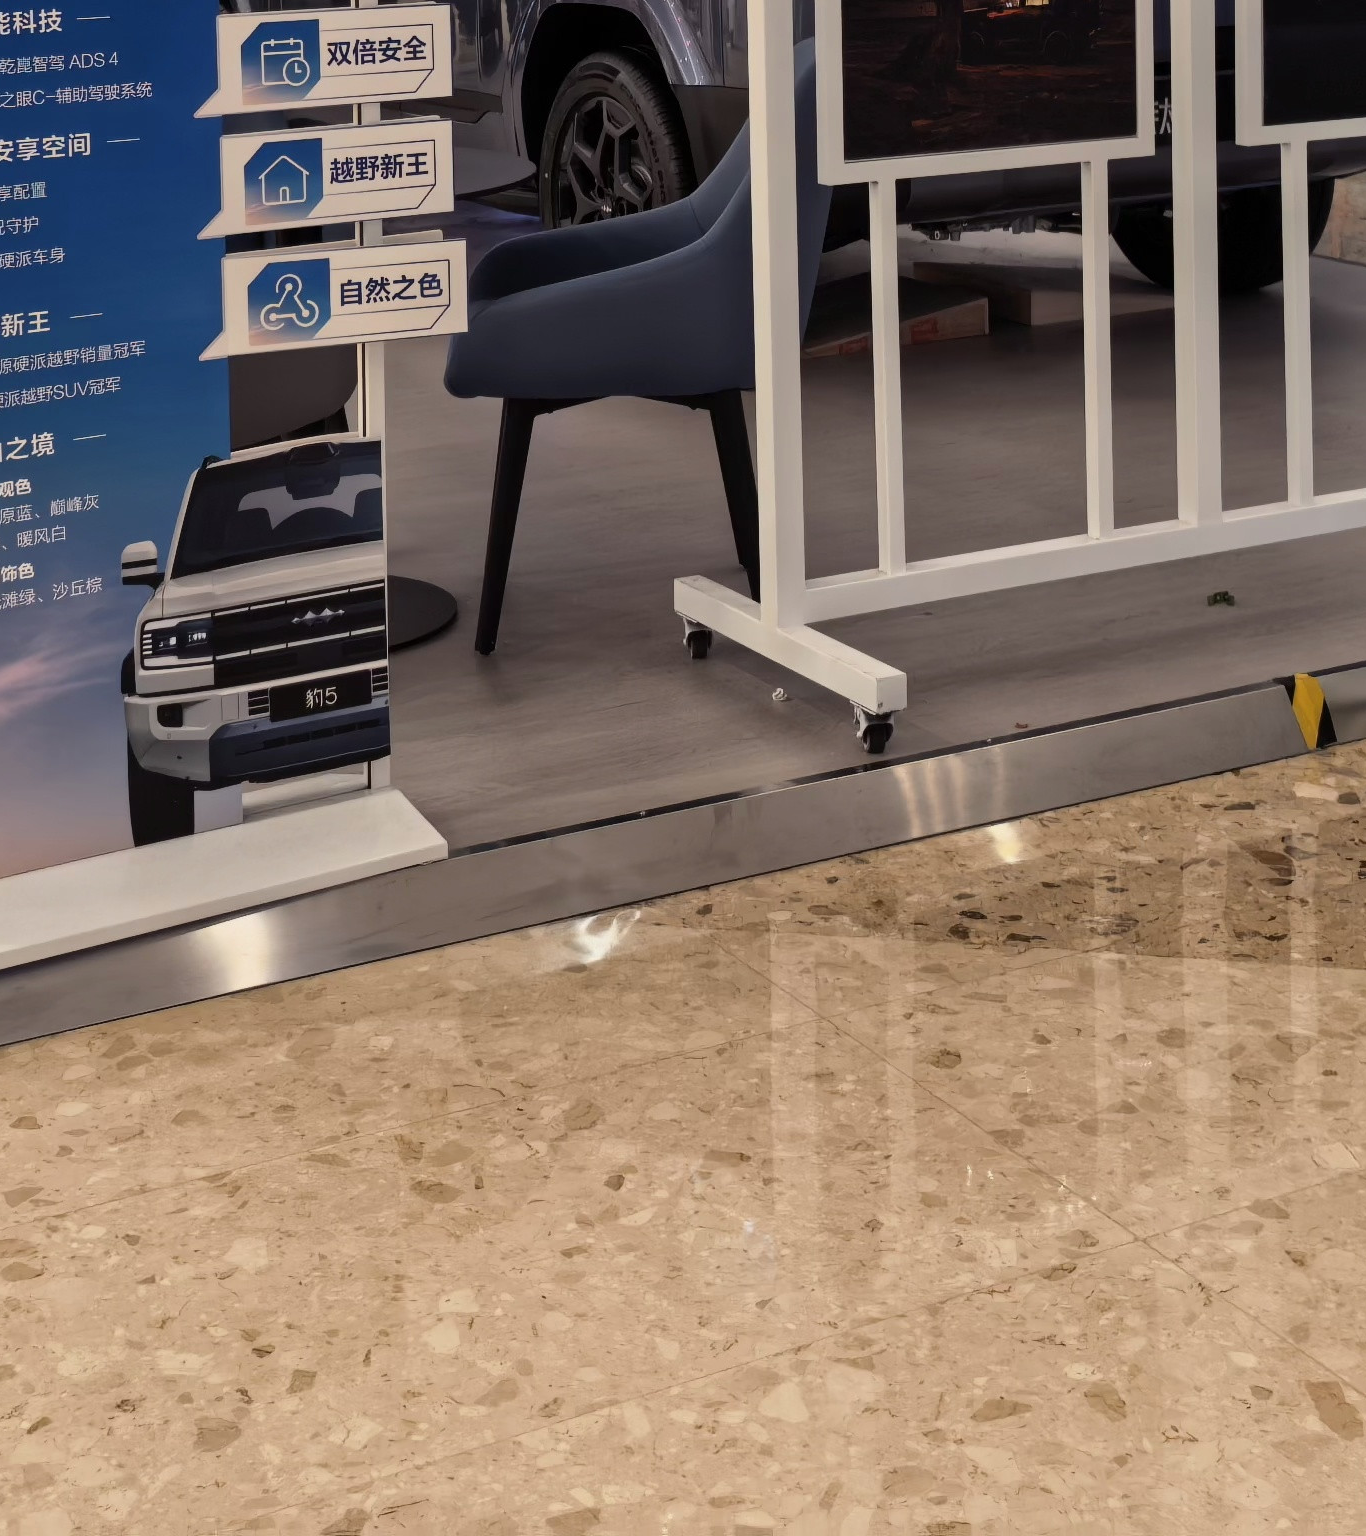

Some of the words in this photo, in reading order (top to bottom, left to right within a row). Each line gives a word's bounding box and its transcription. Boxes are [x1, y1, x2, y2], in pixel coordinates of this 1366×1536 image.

[69, 52, 105, 70] ADS
[108, 52, 119, 67] 4
[327, 36, 427, 66] 双倍安全
[330, 152, 429, 185] 越野新王
[340, 273, 443, 306] 自然之色
[306, 687, 337, 709] 豹5
